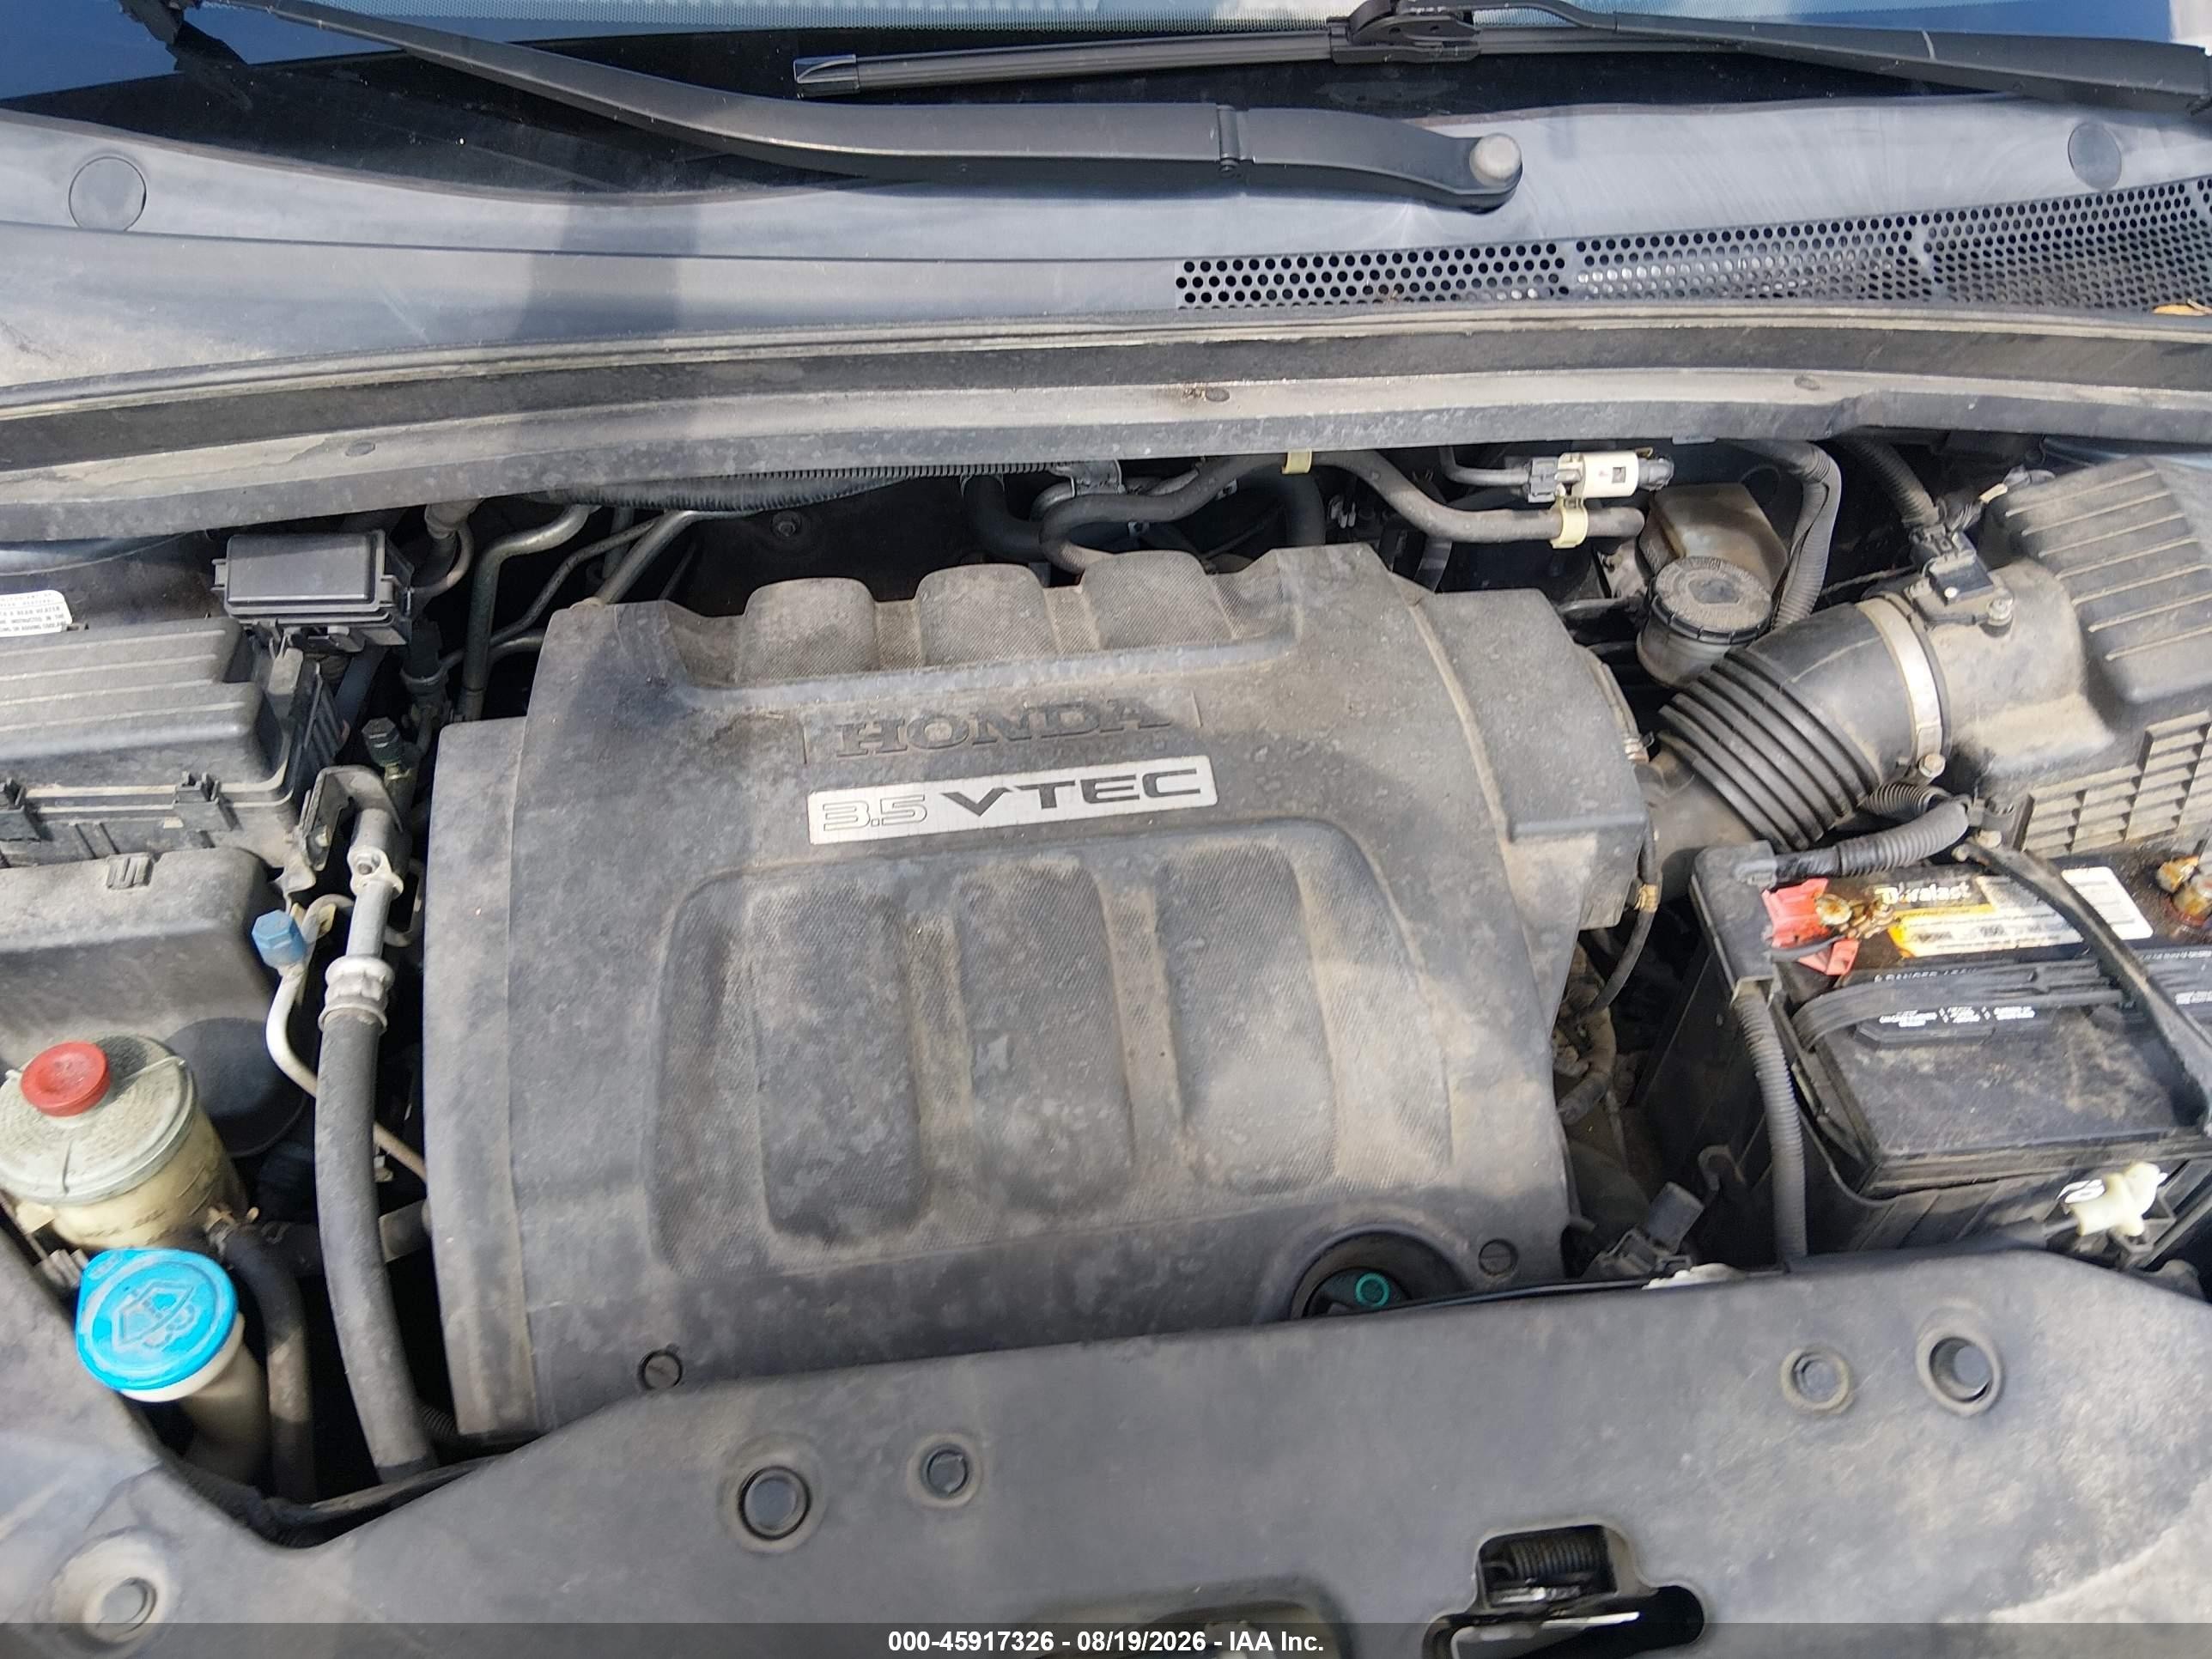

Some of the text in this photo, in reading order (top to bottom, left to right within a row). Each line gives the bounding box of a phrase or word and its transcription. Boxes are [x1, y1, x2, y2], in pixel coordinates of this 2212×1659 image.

[836, 698, 1172, 759] HONDA
[822, 768, 1202, 832] 3.5 VTEC
